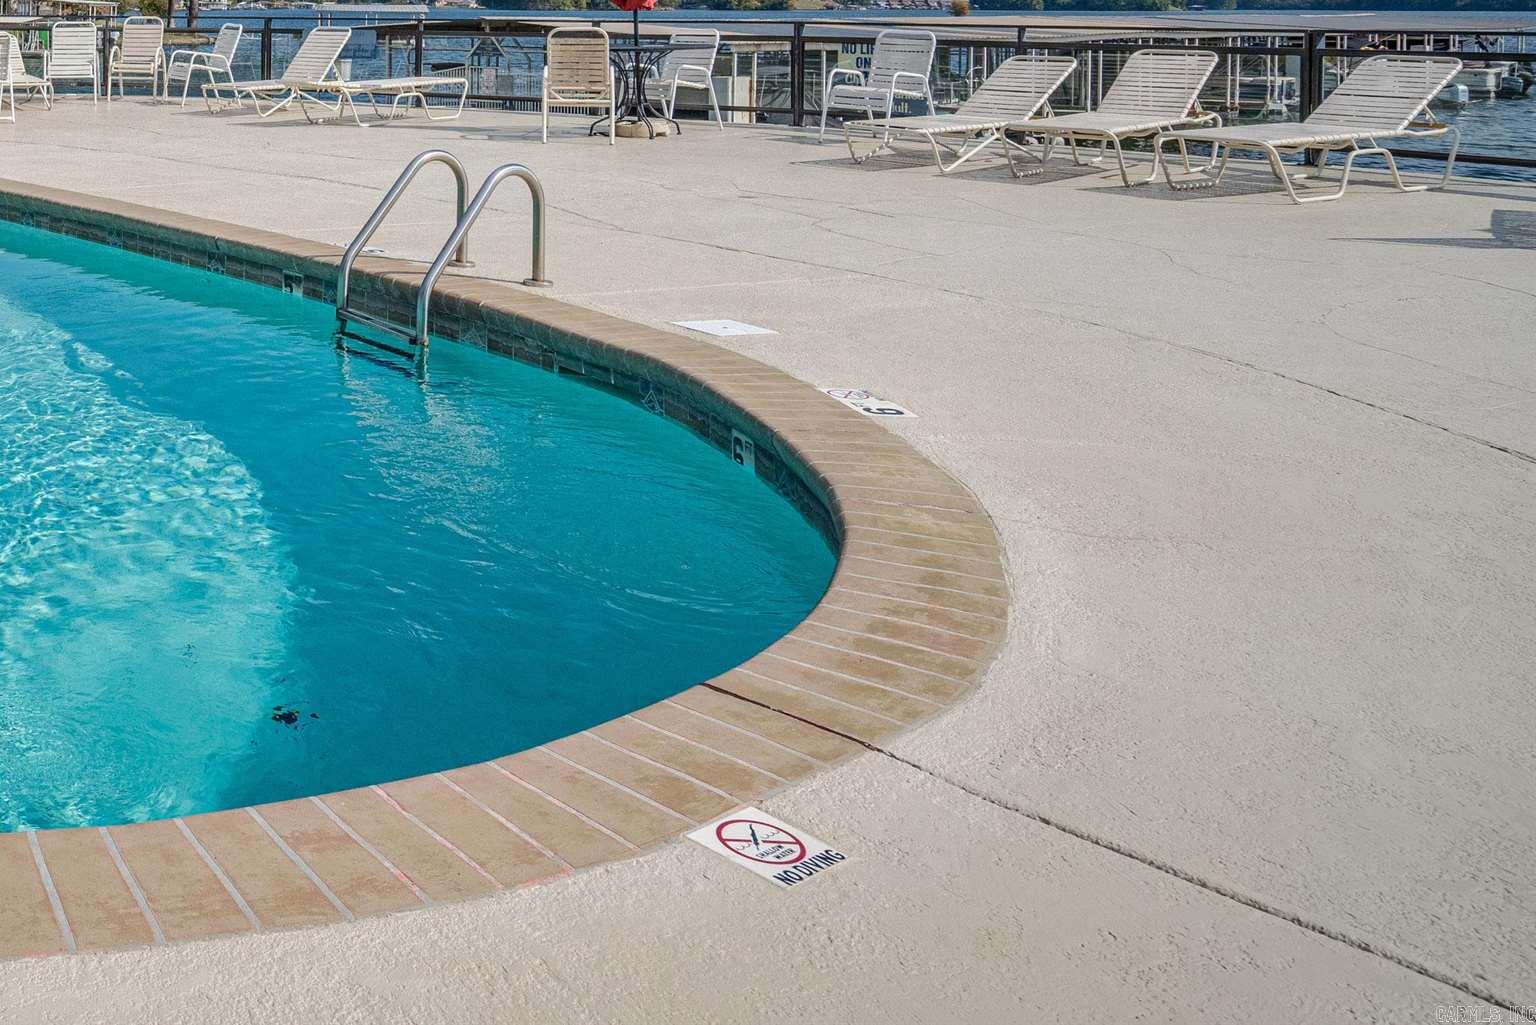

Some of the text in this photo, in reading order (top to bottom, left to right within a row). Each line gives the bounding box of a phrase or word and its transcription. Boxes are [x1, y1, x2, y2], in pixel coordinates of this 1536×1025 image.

[841, 40, 857, 54] NO
[855, 56, 872, 69] ON
[772, 848, 847, 886] NO DIVING
